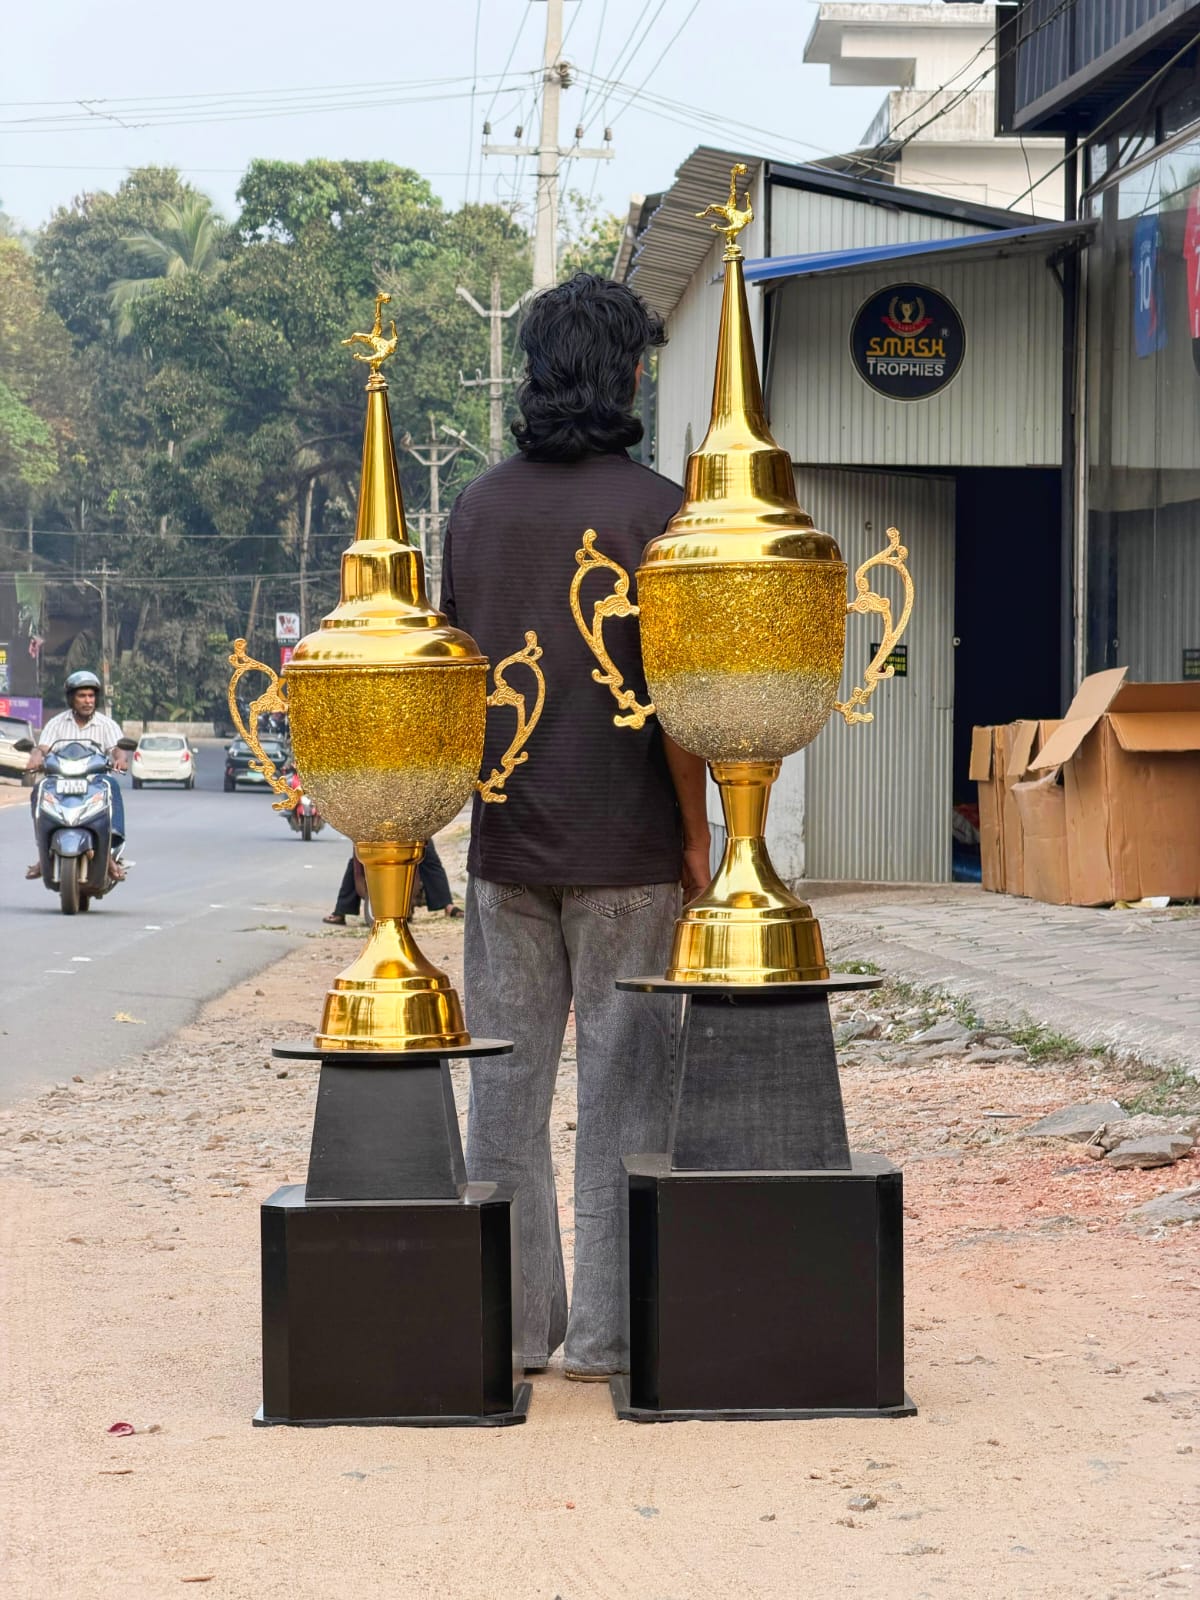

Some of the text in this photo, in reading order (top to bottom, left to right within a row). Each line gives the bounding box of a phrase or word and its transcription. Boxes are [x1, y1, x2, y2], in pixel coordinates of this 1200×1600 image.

[1140, 257, 1152, 312] 10
[866, 337, 946, 358] SMASH
[867, 358, 944, 377] TROPHIES
